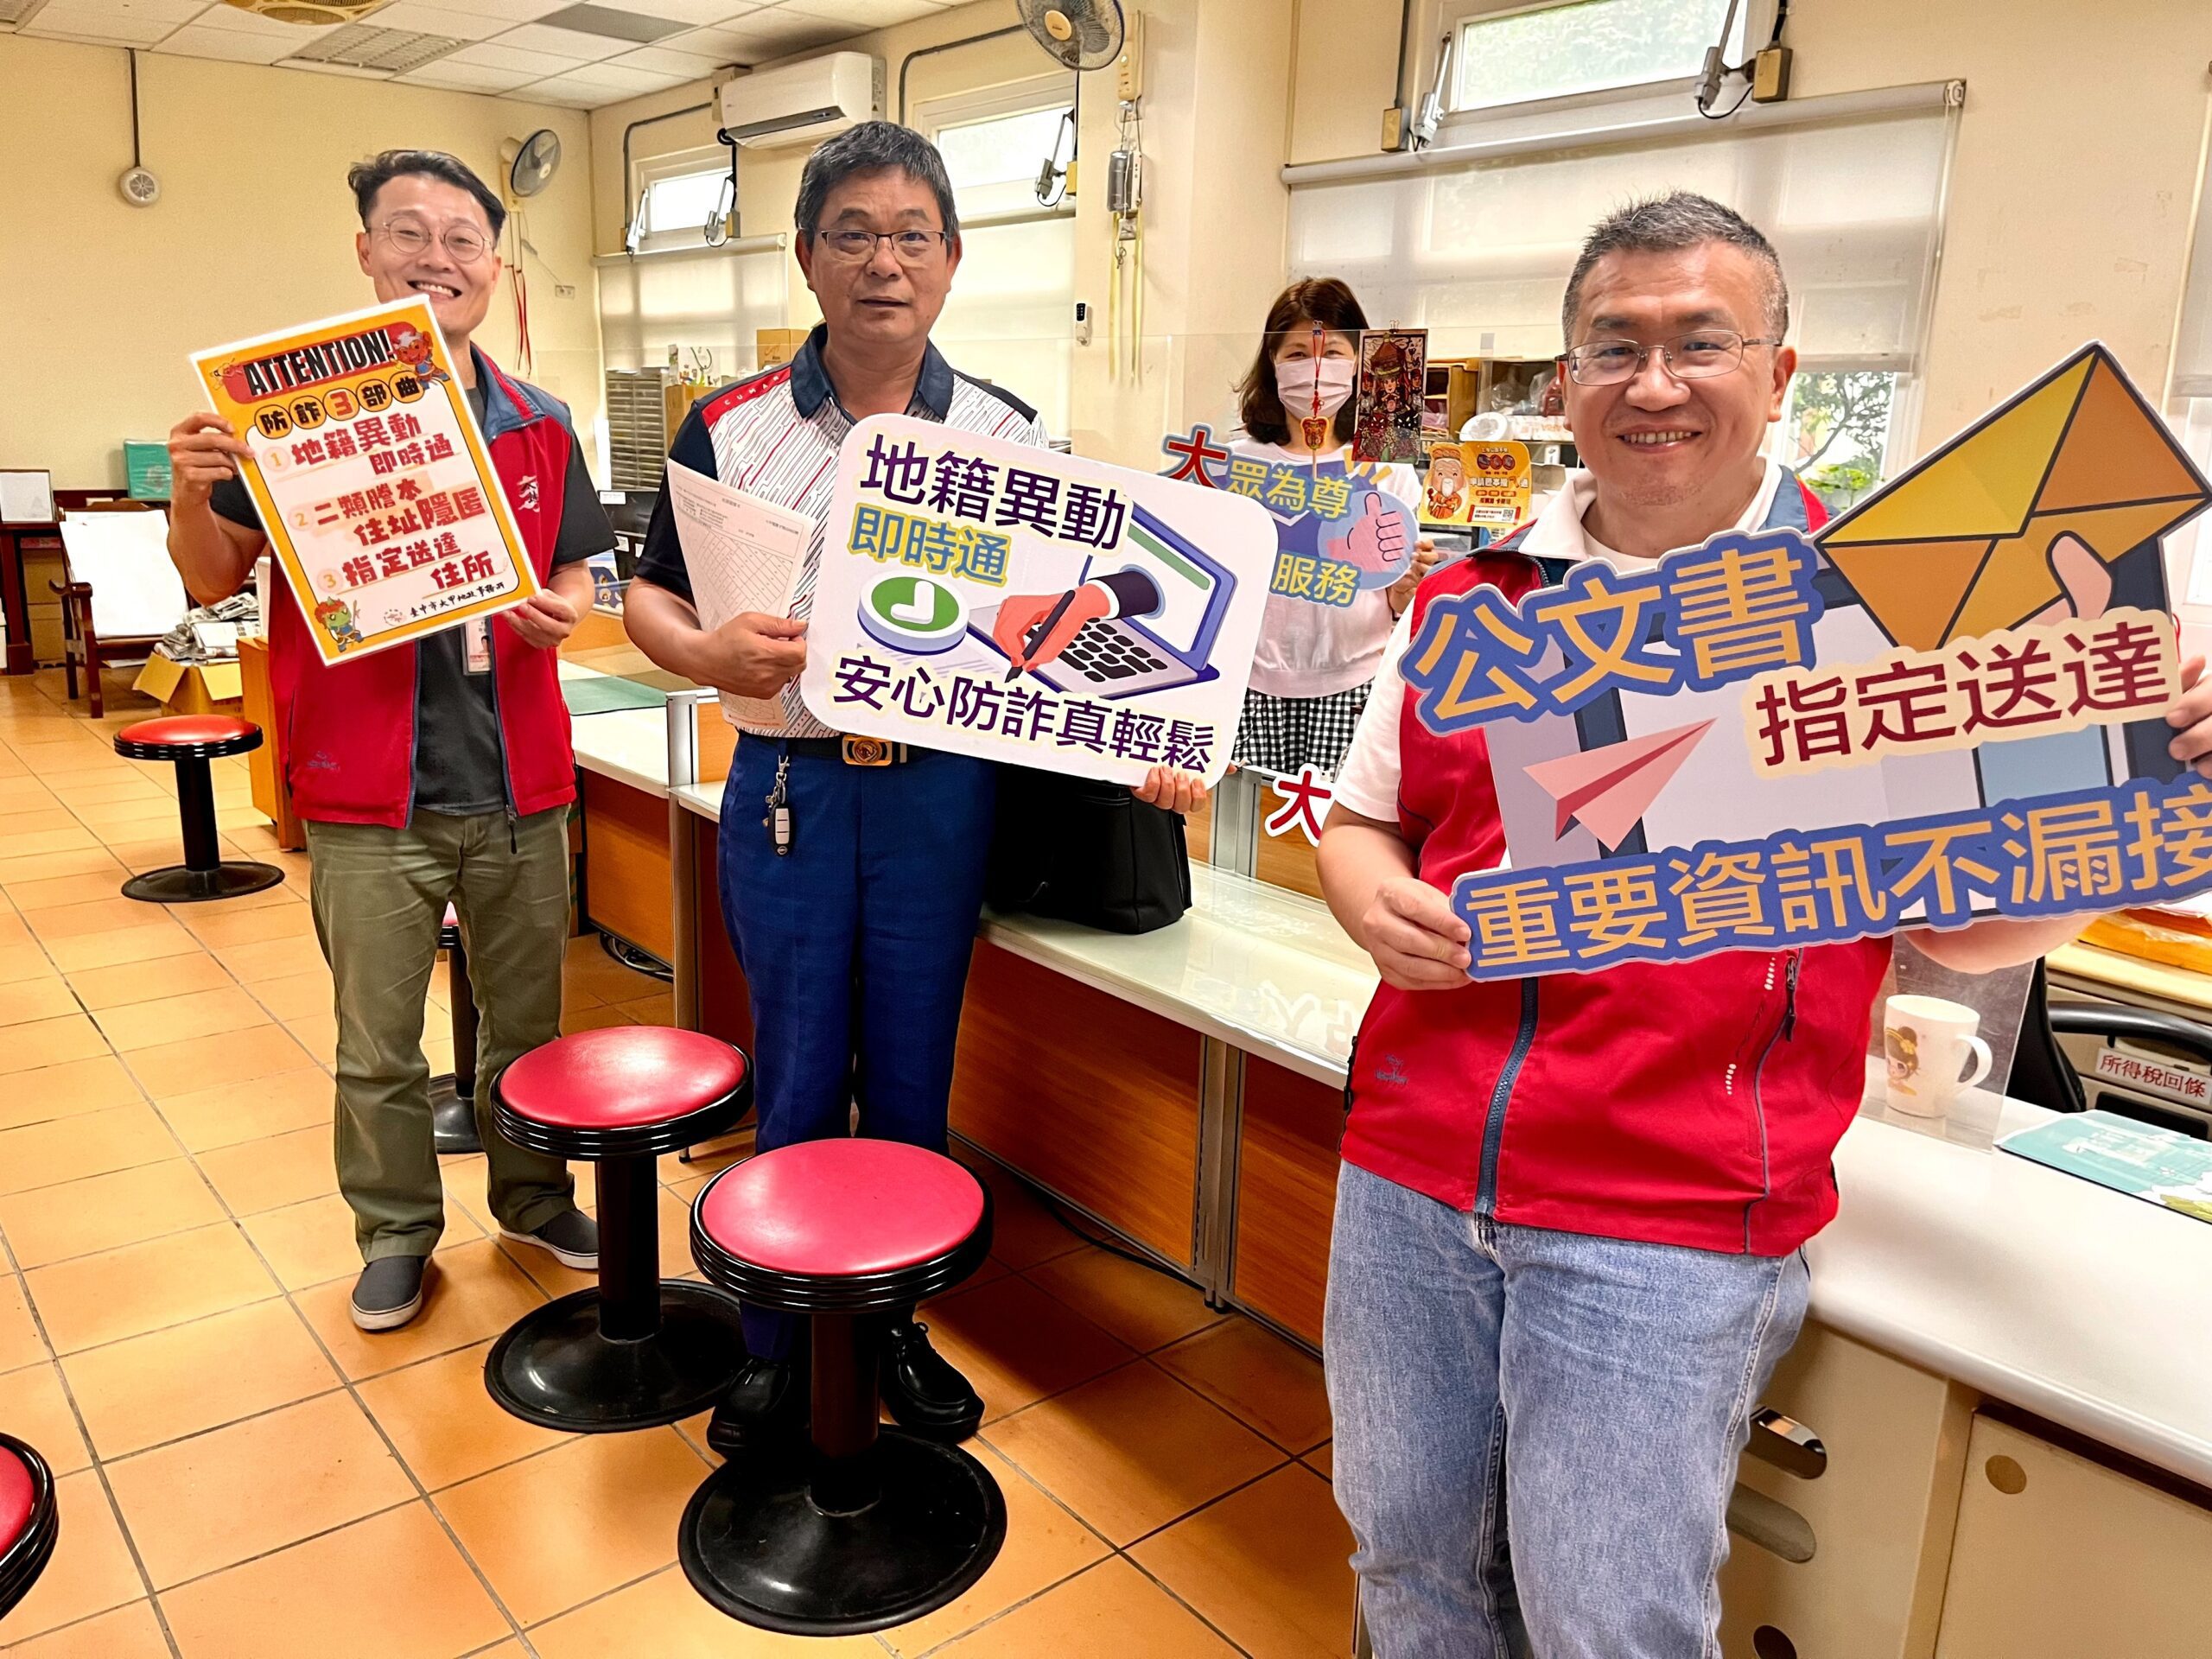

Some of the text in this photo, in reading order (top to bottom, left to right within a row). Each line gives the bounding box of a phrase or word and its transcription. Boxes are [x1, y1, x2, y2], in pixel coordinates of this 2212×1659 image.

[244, 329, 396, 397] ATTENTION!
[260, 375, 421, 434] 防詐3部曲
[291, 412, 423, 466] 地籍異動
[371, 437, 457, 476] 即時通
[315, 479, 422, 524] 二類謄本
[859, 434, 1127, 550] 地籍異動
[1168, 430, 1352, 520] 大眾為尊
[353, 486, 486, 547] 住址隱匿
[851, 507, 1011, 585] 即時通
[341, 532, 462, 587] 指定送達
[429, 550, 496, 591] 住所
[1272, 555, 1358, 605] 服務
[1415, 548, 1802, 722] 公文書
[833, 653, 1215, 775] 安心防詐真輕鬆
[1758, 621, 2171, 766] 指定送達
[1465, 784, 2212, 969] 重要資訊不漏接
[2099, 1054, 2208, 1098] 所得稅回條
